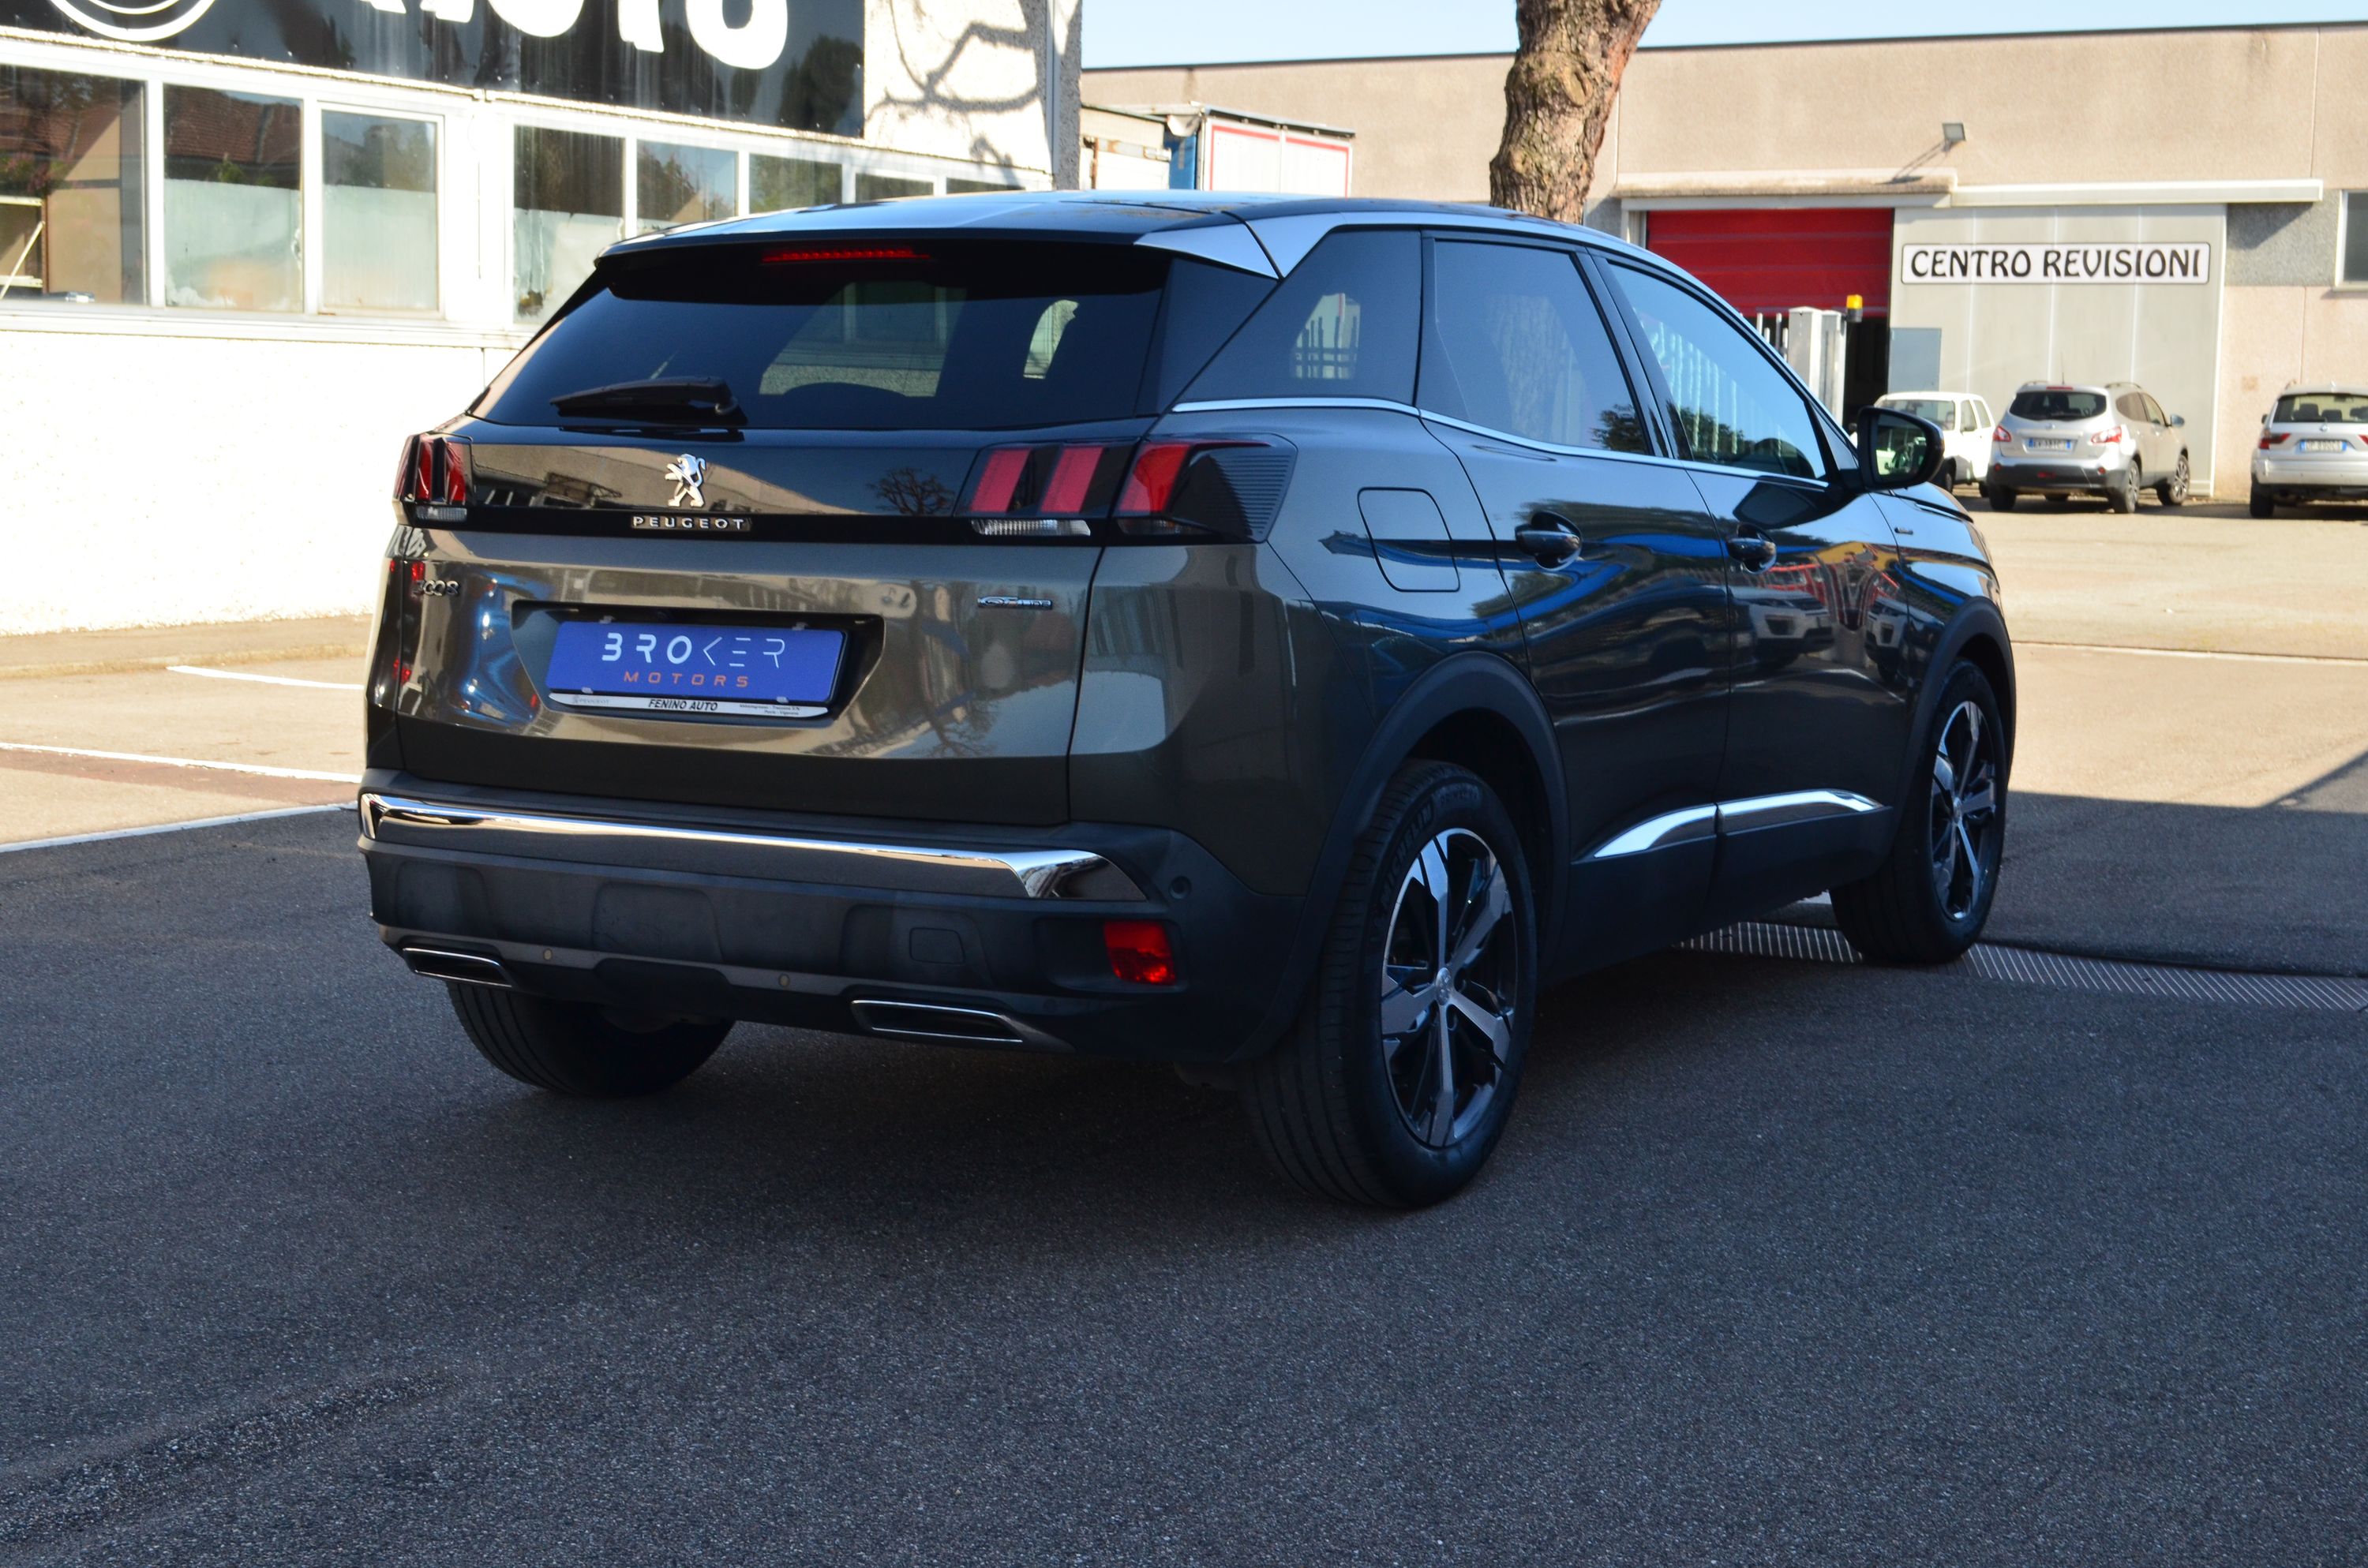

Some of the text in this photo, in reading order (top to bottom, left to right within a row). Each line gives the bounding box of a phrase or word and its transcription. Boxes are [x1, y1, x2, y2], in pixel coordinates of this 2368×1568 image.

[1910, 249, 2201, 279] CENTRO REVISIONI
[632, 515, 744, 530] PEUGEOT
[624, 671, 749, 688] MOTORS
[648, 698, 719, 712] FENINO AUTO
